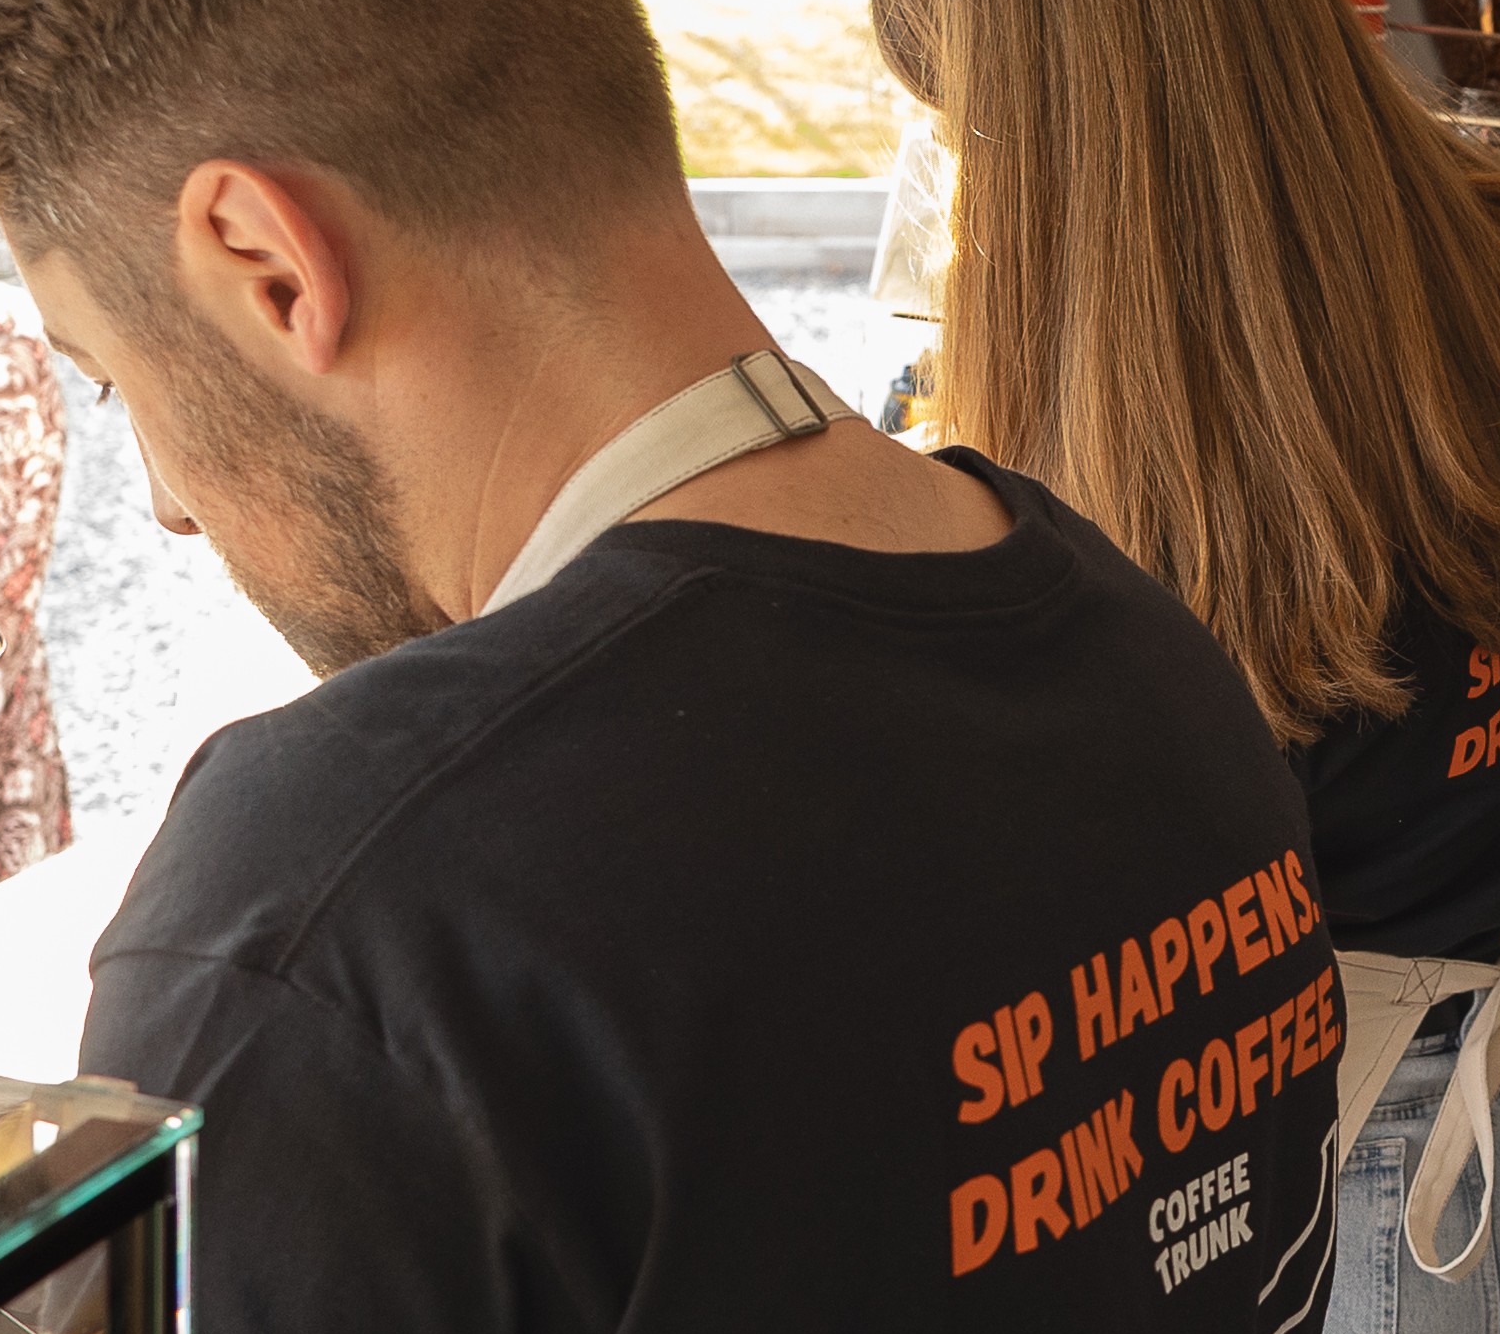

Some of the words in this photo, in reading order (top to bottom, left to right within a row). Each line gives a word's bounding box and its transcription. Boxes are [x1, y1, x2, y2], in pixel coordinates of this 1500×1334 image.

[952, 990, 1054, 1125] SIP
[1070, 848, 1321, 1063] HAPPENS.
[949, 1088, 1145, 1278] DRINK
[1157, 964, 1342, 1154] COFFEE.
[1148, 1151, 1251, 1243] COFFEE
[1153, 1200, 1254, 1295] TRUNK
